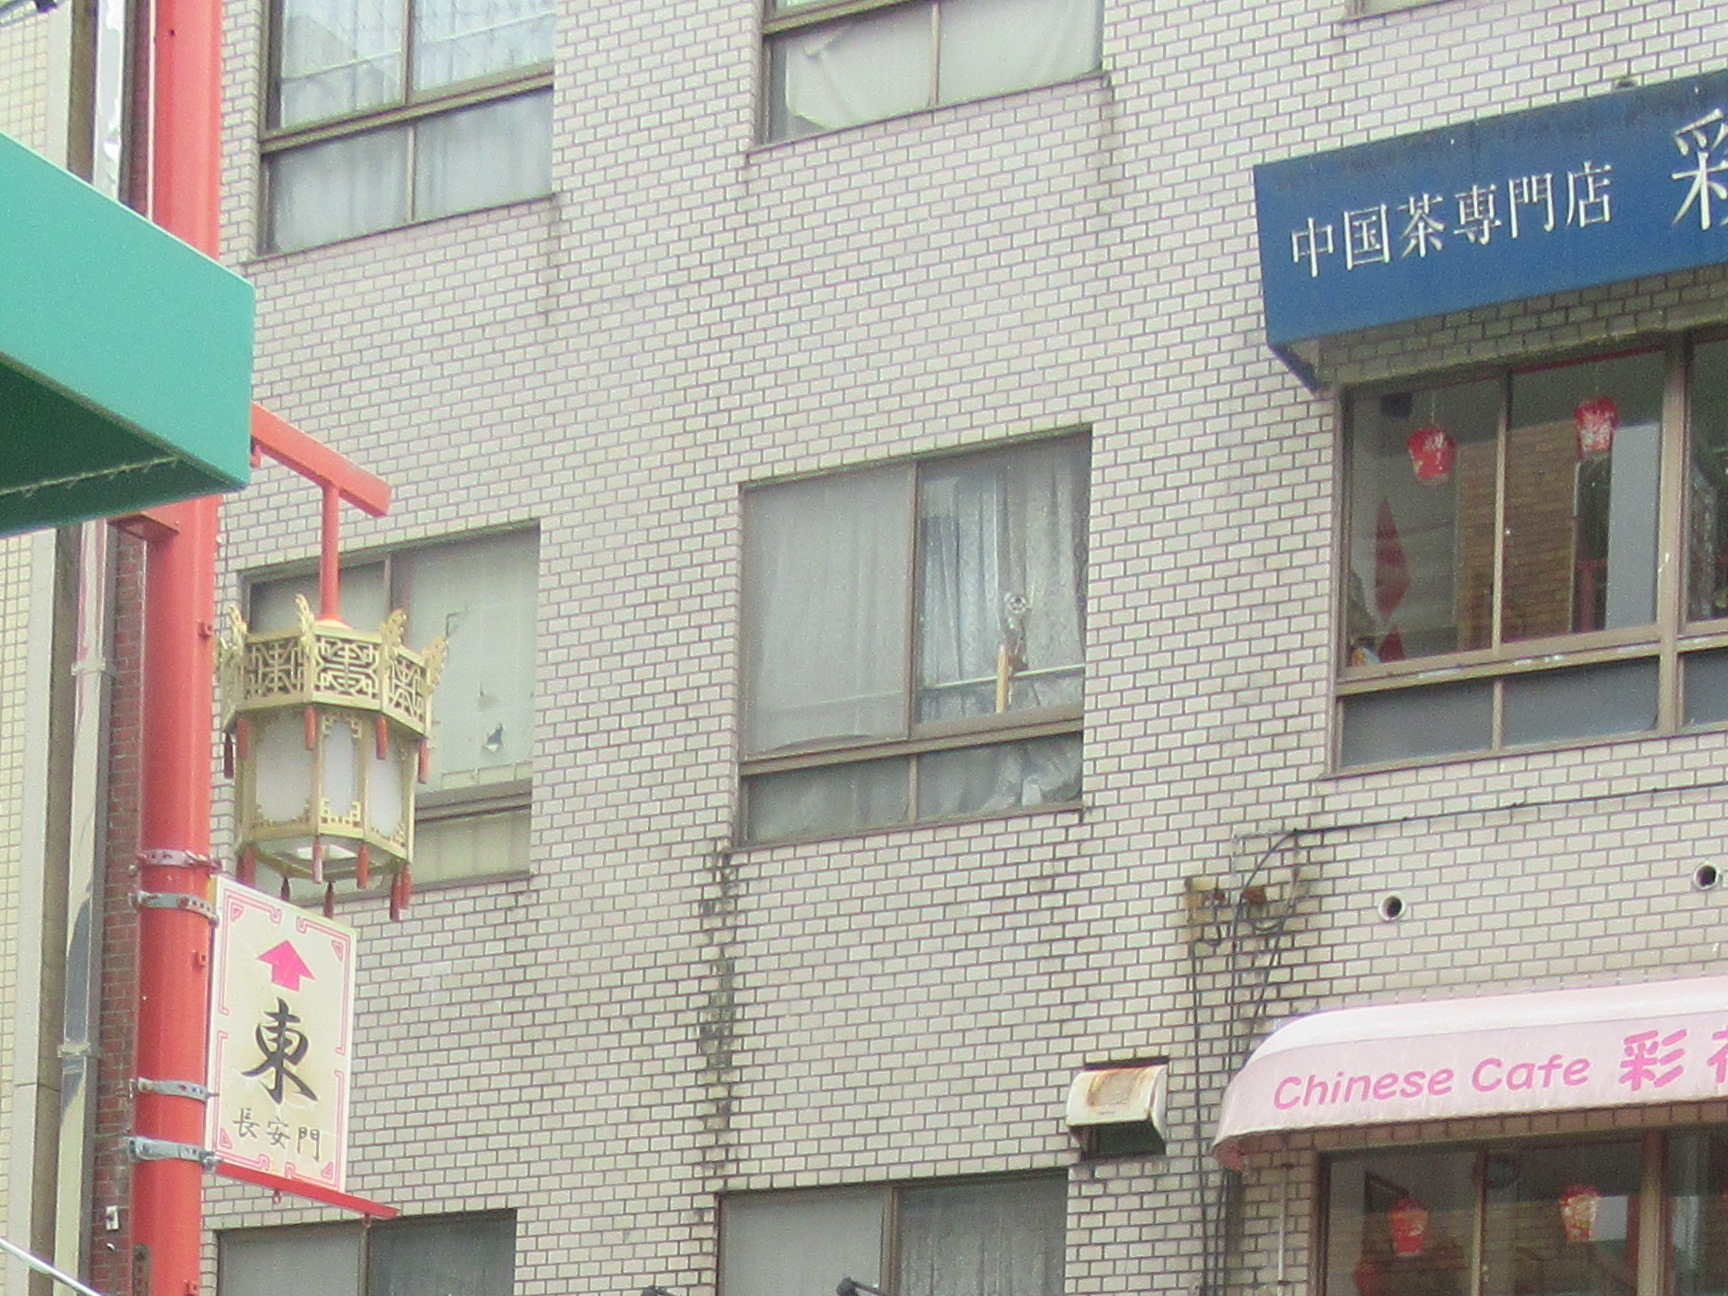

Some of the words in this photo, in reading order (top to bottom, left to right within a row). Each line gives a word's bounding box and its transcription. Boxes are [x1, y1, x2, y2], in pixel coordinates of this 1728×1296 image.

[1290, 160, 1613, 279] 中国茶専門店
[241, 999, 318, 1104] 東
[1273, 1064, 1455, 1112] Chinese
[1471, 1053, 1591, 1095] Cafe
[233, 1107, 323, 1163] 長安門
